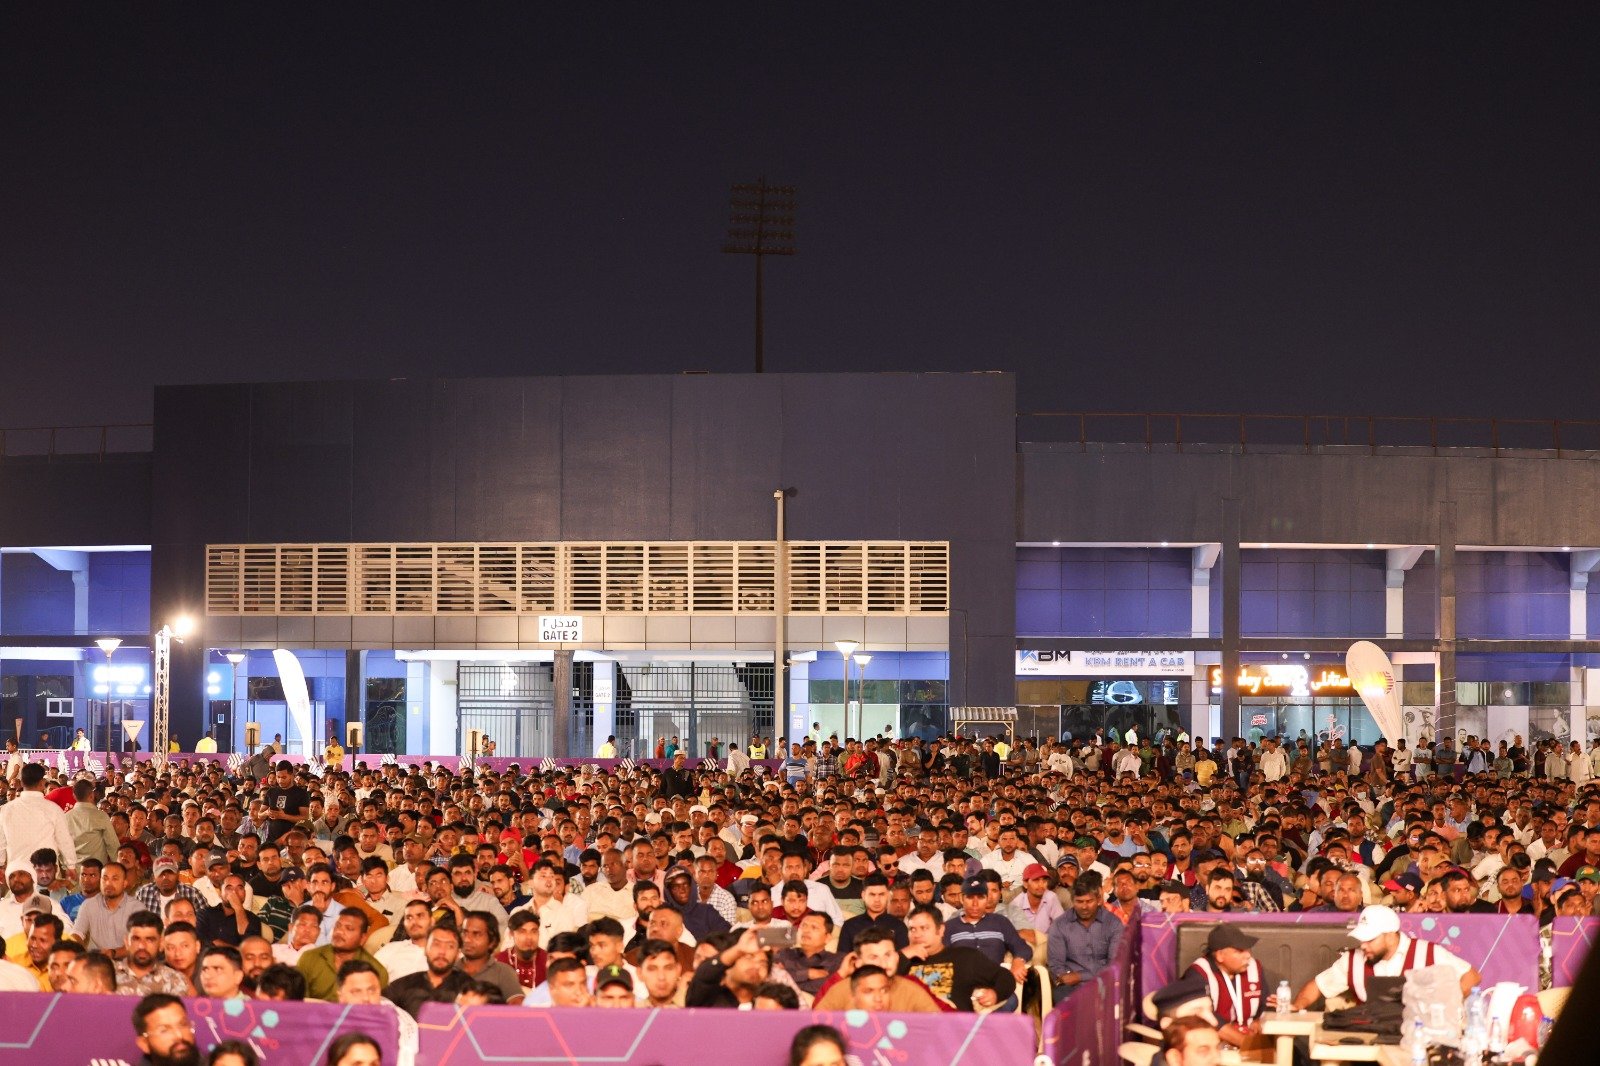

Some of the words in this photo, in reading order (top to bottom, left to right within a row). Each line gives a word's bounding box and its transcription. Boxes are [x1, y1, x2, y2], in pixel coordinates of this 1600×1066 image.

[551, 617, 578, 630] مدخل
[543, 630, 569, 641] GATE
[571, 630, 578, 641] 2
[1020, 649, 1071, 663] KBM
[1085, 657, 1111, 667] KBM
[1114, 657, 1145, 668] RENT
[1148, 657, 1157, 668] A
[1160, 657, 1185, 667] CAR
